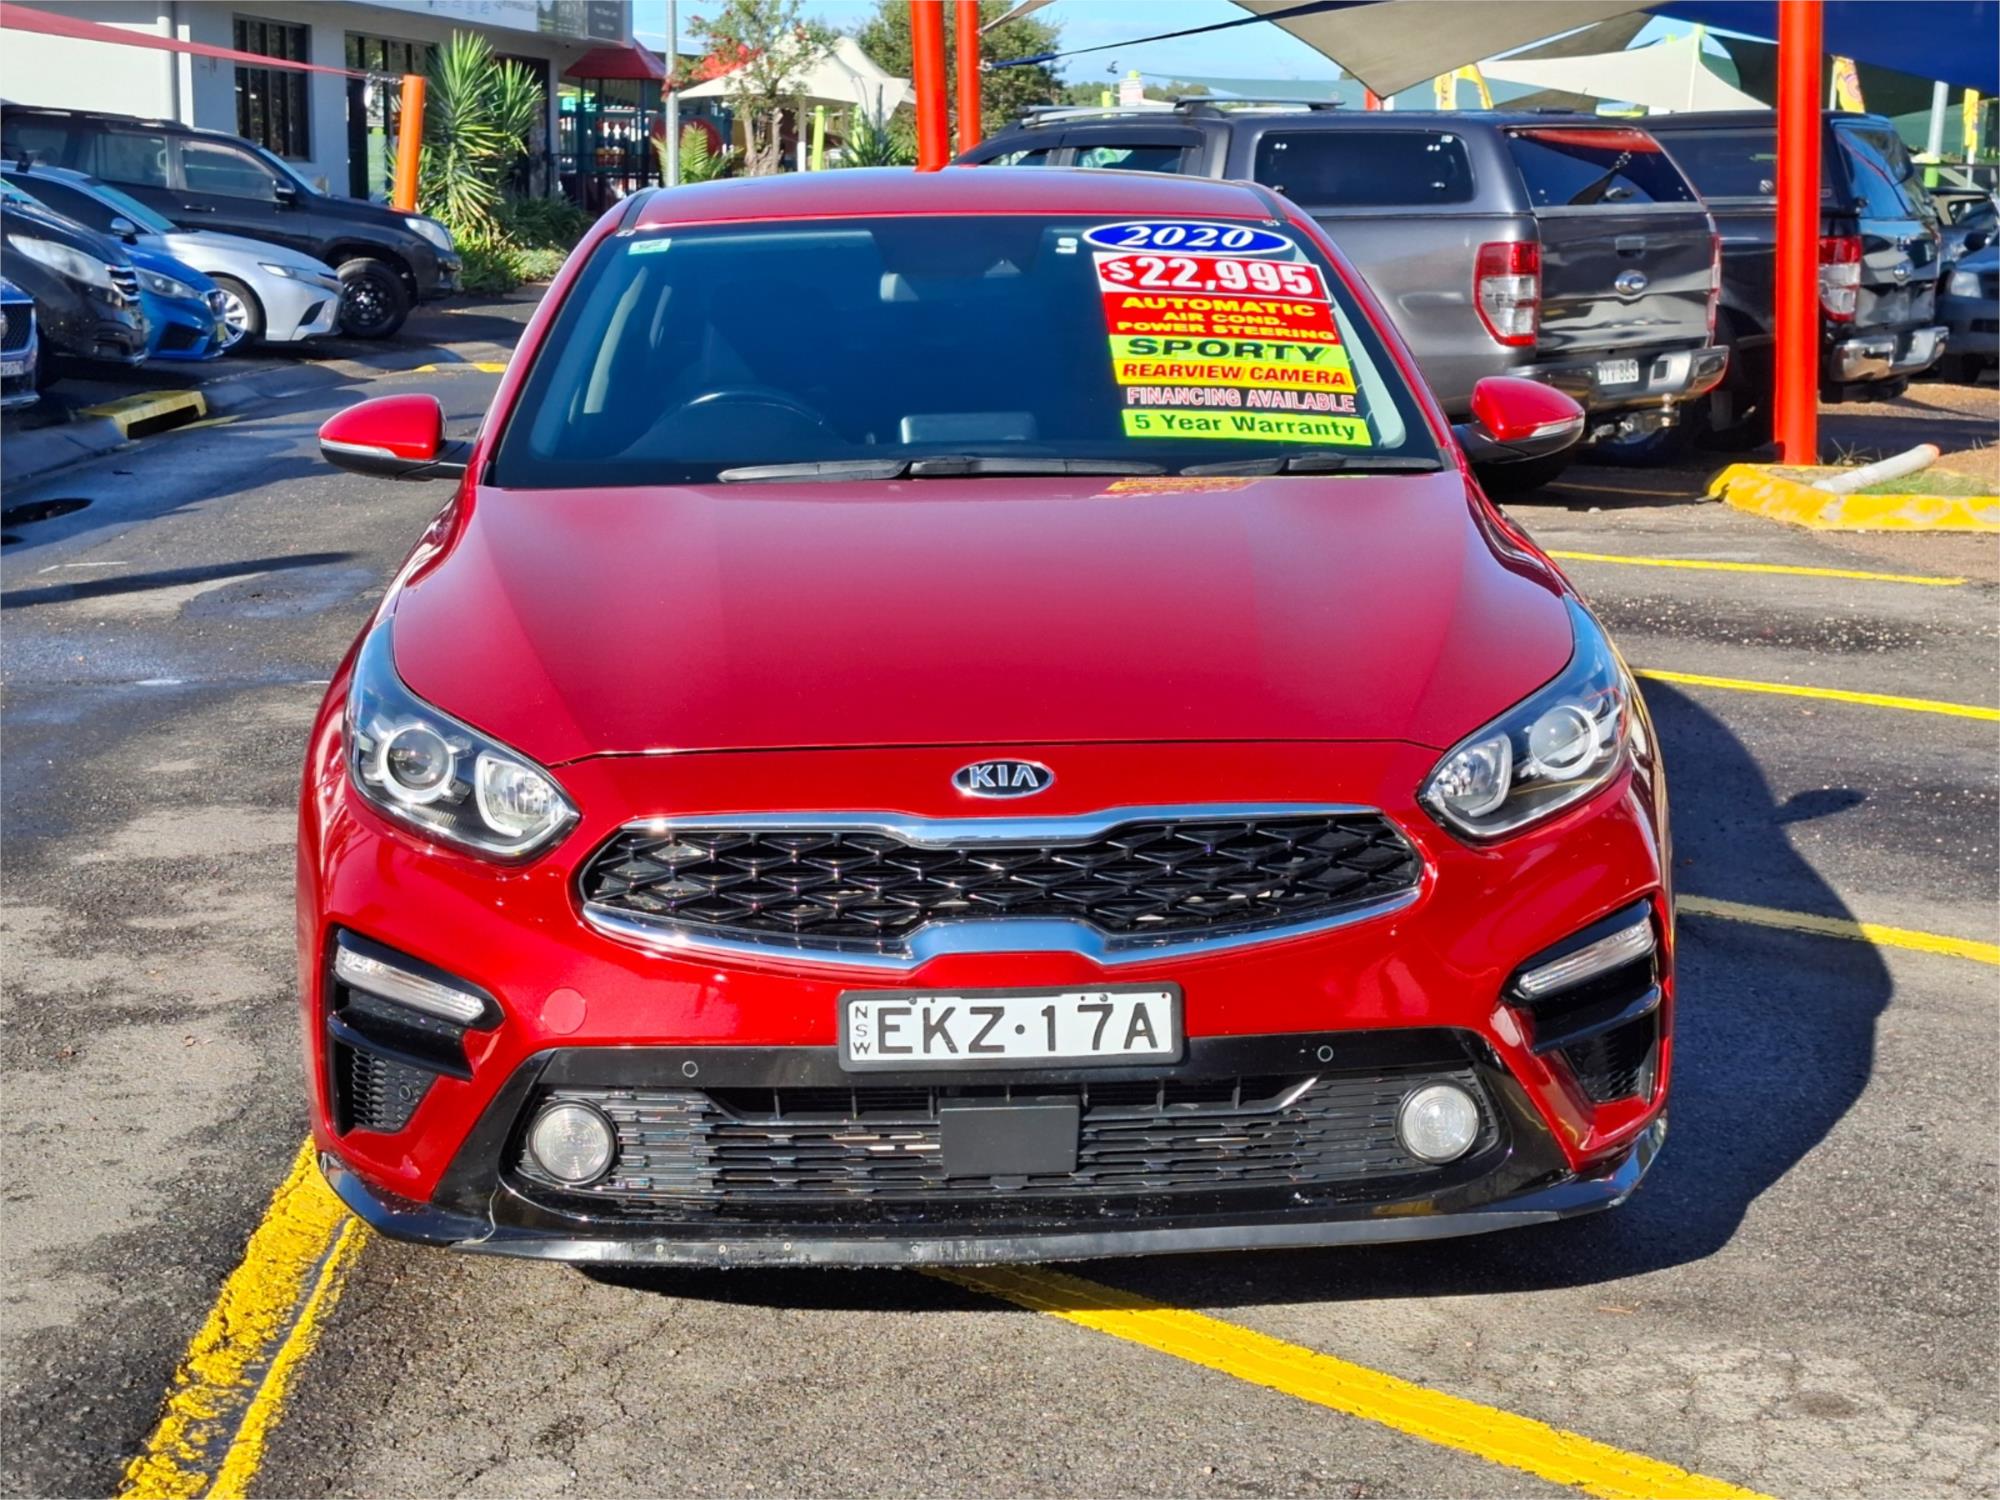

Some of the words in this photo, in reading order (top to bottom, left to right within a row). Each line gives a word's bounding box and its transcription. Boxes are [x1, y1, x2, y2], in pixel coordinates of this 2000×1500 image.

[1117, 225, 1255, 248] 2020
[1105, 256, 1313, 295] $22,995
[1122, 297, 1316, 317] AUTOMATIC
[1163, 312, 1205, 322] AIR
[1212, 313, 1287, 325] COND.
[1117, 321, 1207, 333] POWER
[1213, 323, 1335, 340] STEERING
[1128, 338, 1331, 362] SPORTY
[1123, 364, 1244, 379] REARVIEW
[1250, 366, 1346, 385] CAMERA
[1127, 386, 1241, 406] FINANCING
[1246, 389, 1356, 413] AVAILABLE
[1135, 414, 1150, 429] 5
[1160, 414, 1221, 431] Year
[1231, 415, 1355, 440] Warranty
[969, 765, 1039, 788] KIA
